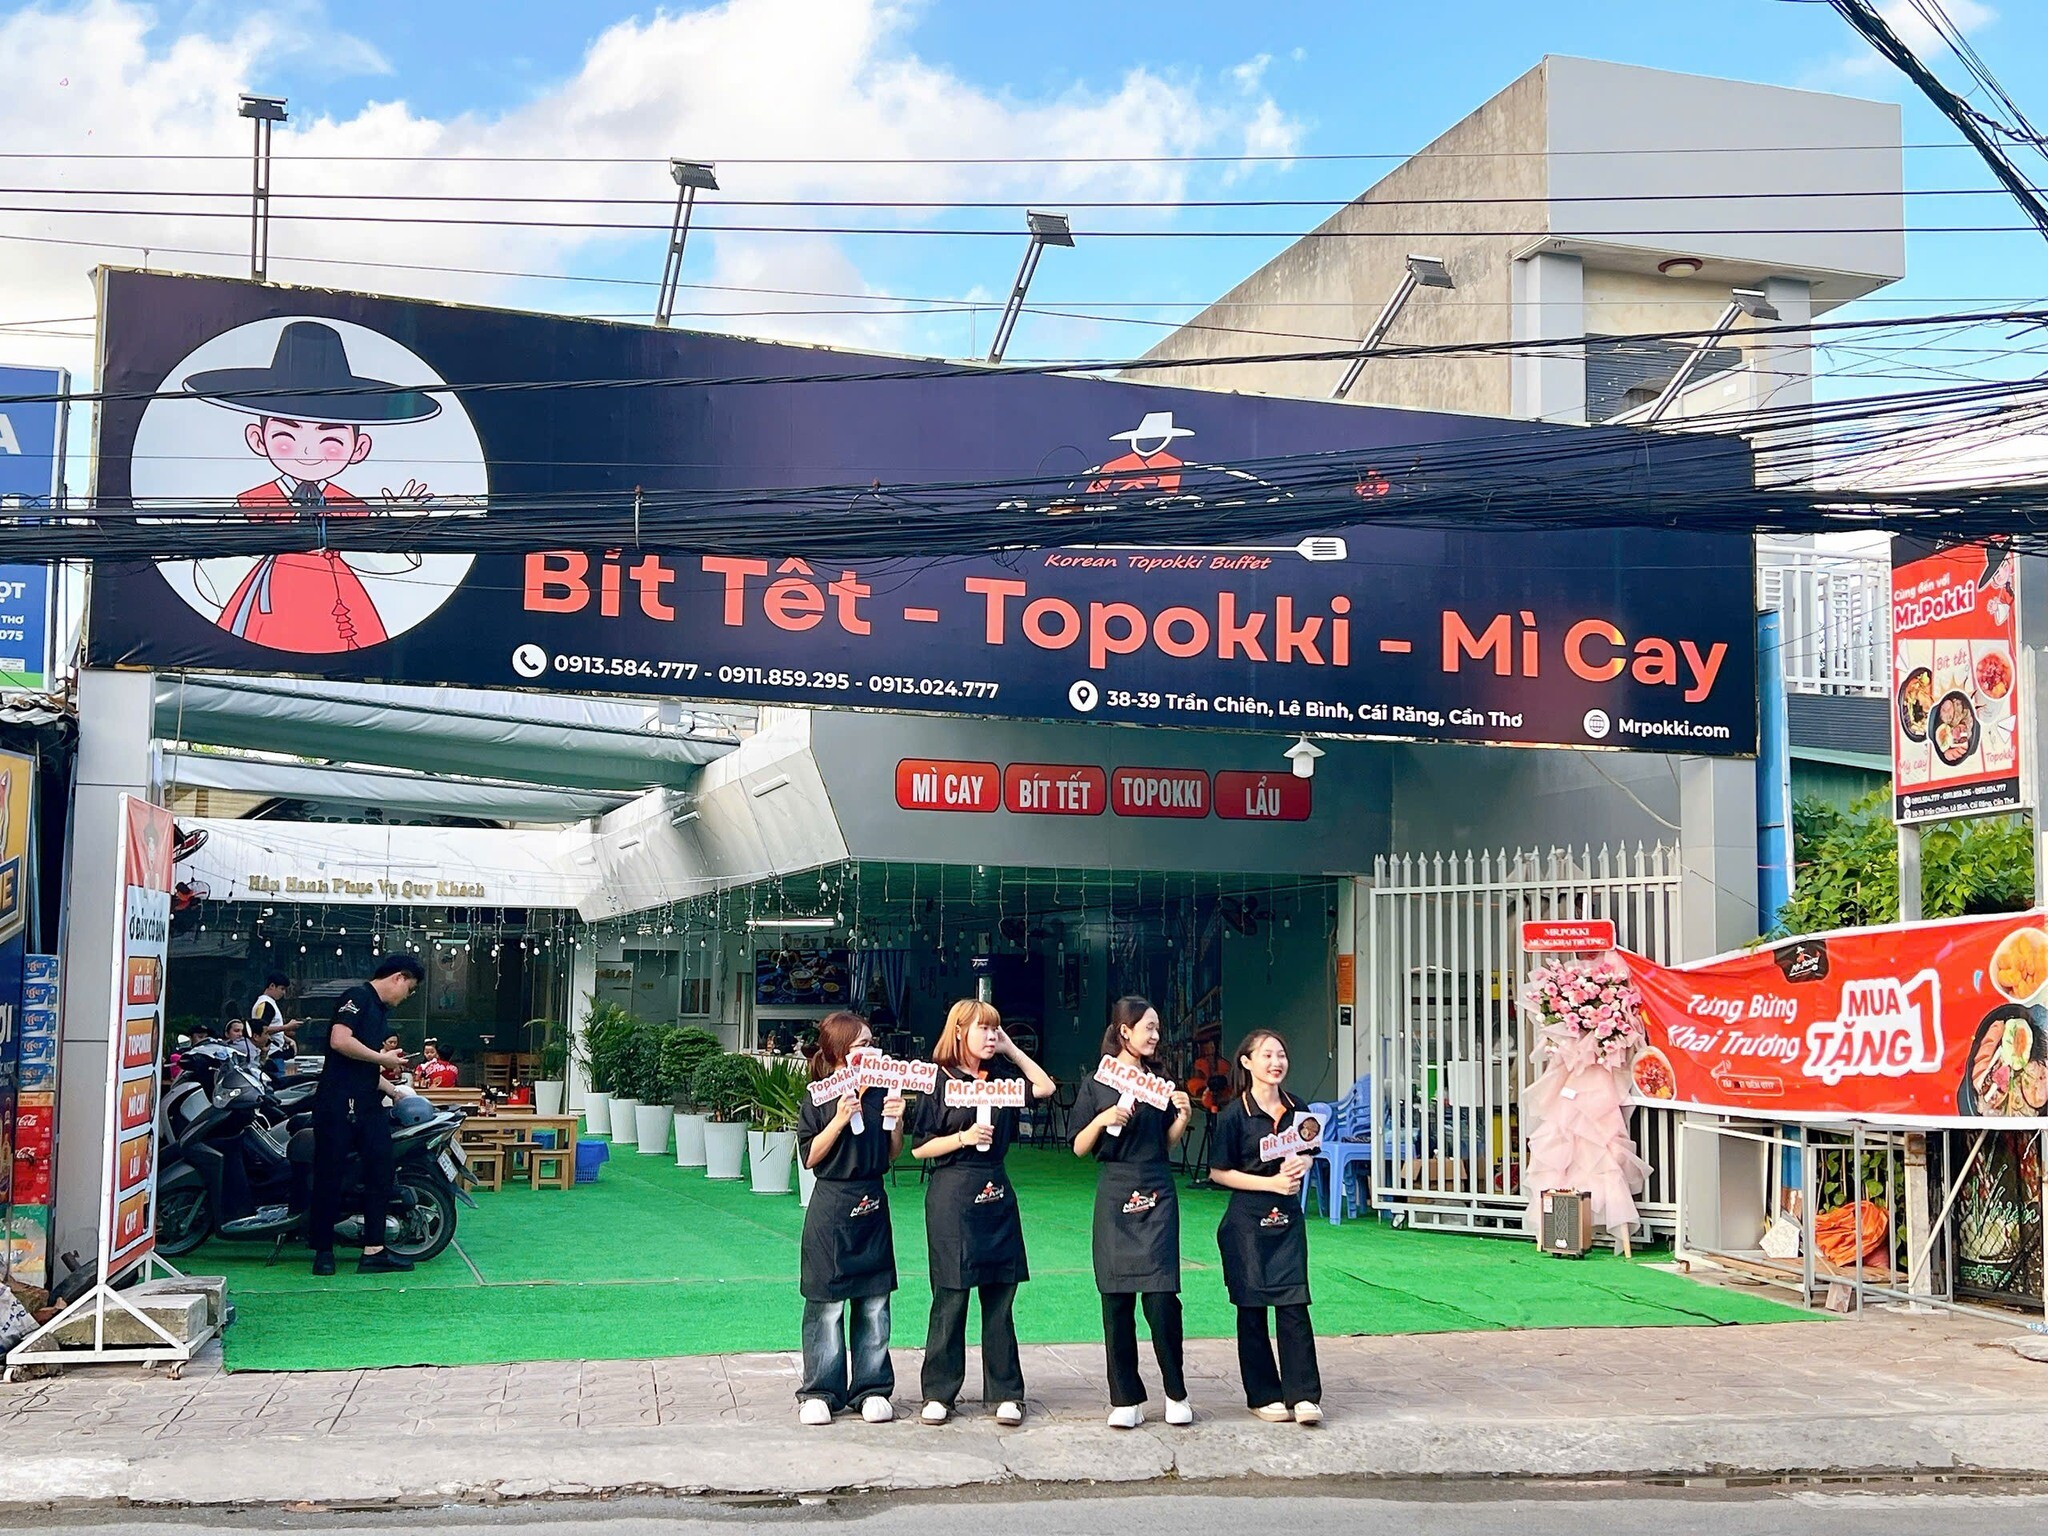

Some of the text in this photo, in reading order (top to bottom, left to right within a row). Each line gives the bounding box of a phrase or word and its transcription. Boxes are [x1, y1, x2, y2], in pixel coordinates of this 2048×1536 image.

[1043, 553, 1272, 573] Korean Topokki Buffet
[1894, 580, 1974, 632] Mr.Pokki
[964, 576, 1351, 670] Topokki
[1442, 610, 1540, 678] Mì
[1563, 618, 1729, 703] Cay
[554, 654, 699, 682] 0913.584.777
[718, 665, 850, 690] 0911.859.295
[868, 675, 1000, 700] 0913.024.777
[1106, 689, 1524, 728] 38-39 Trần Chiên, Lê Bình, Cái Răng, Cần Thơ
[1618, 717, 1731, 739] Mrpokki.com
[911, 765, 1281, 817] MÌ CAY BÍT TẾT TOPOKKI LẨU
[1748, 992, 1798, 1025] Bừng
[1848, 979, 1934, 1064] MUA 1
[1667, 1024, 1801, 1064] Khai Trương
[1811, 1020, 1912, 1077] TẶNG
[809, 1067, 855, 1094] Topokki
[859, 1073, 934, 1093] Không Nóng
[862, 1056, 937, 1078] Không Cay
[1102, 1057, 1173, 1097] Mr.Pokki
[948, 1081, 1023, 1096] Mr.Pokki
